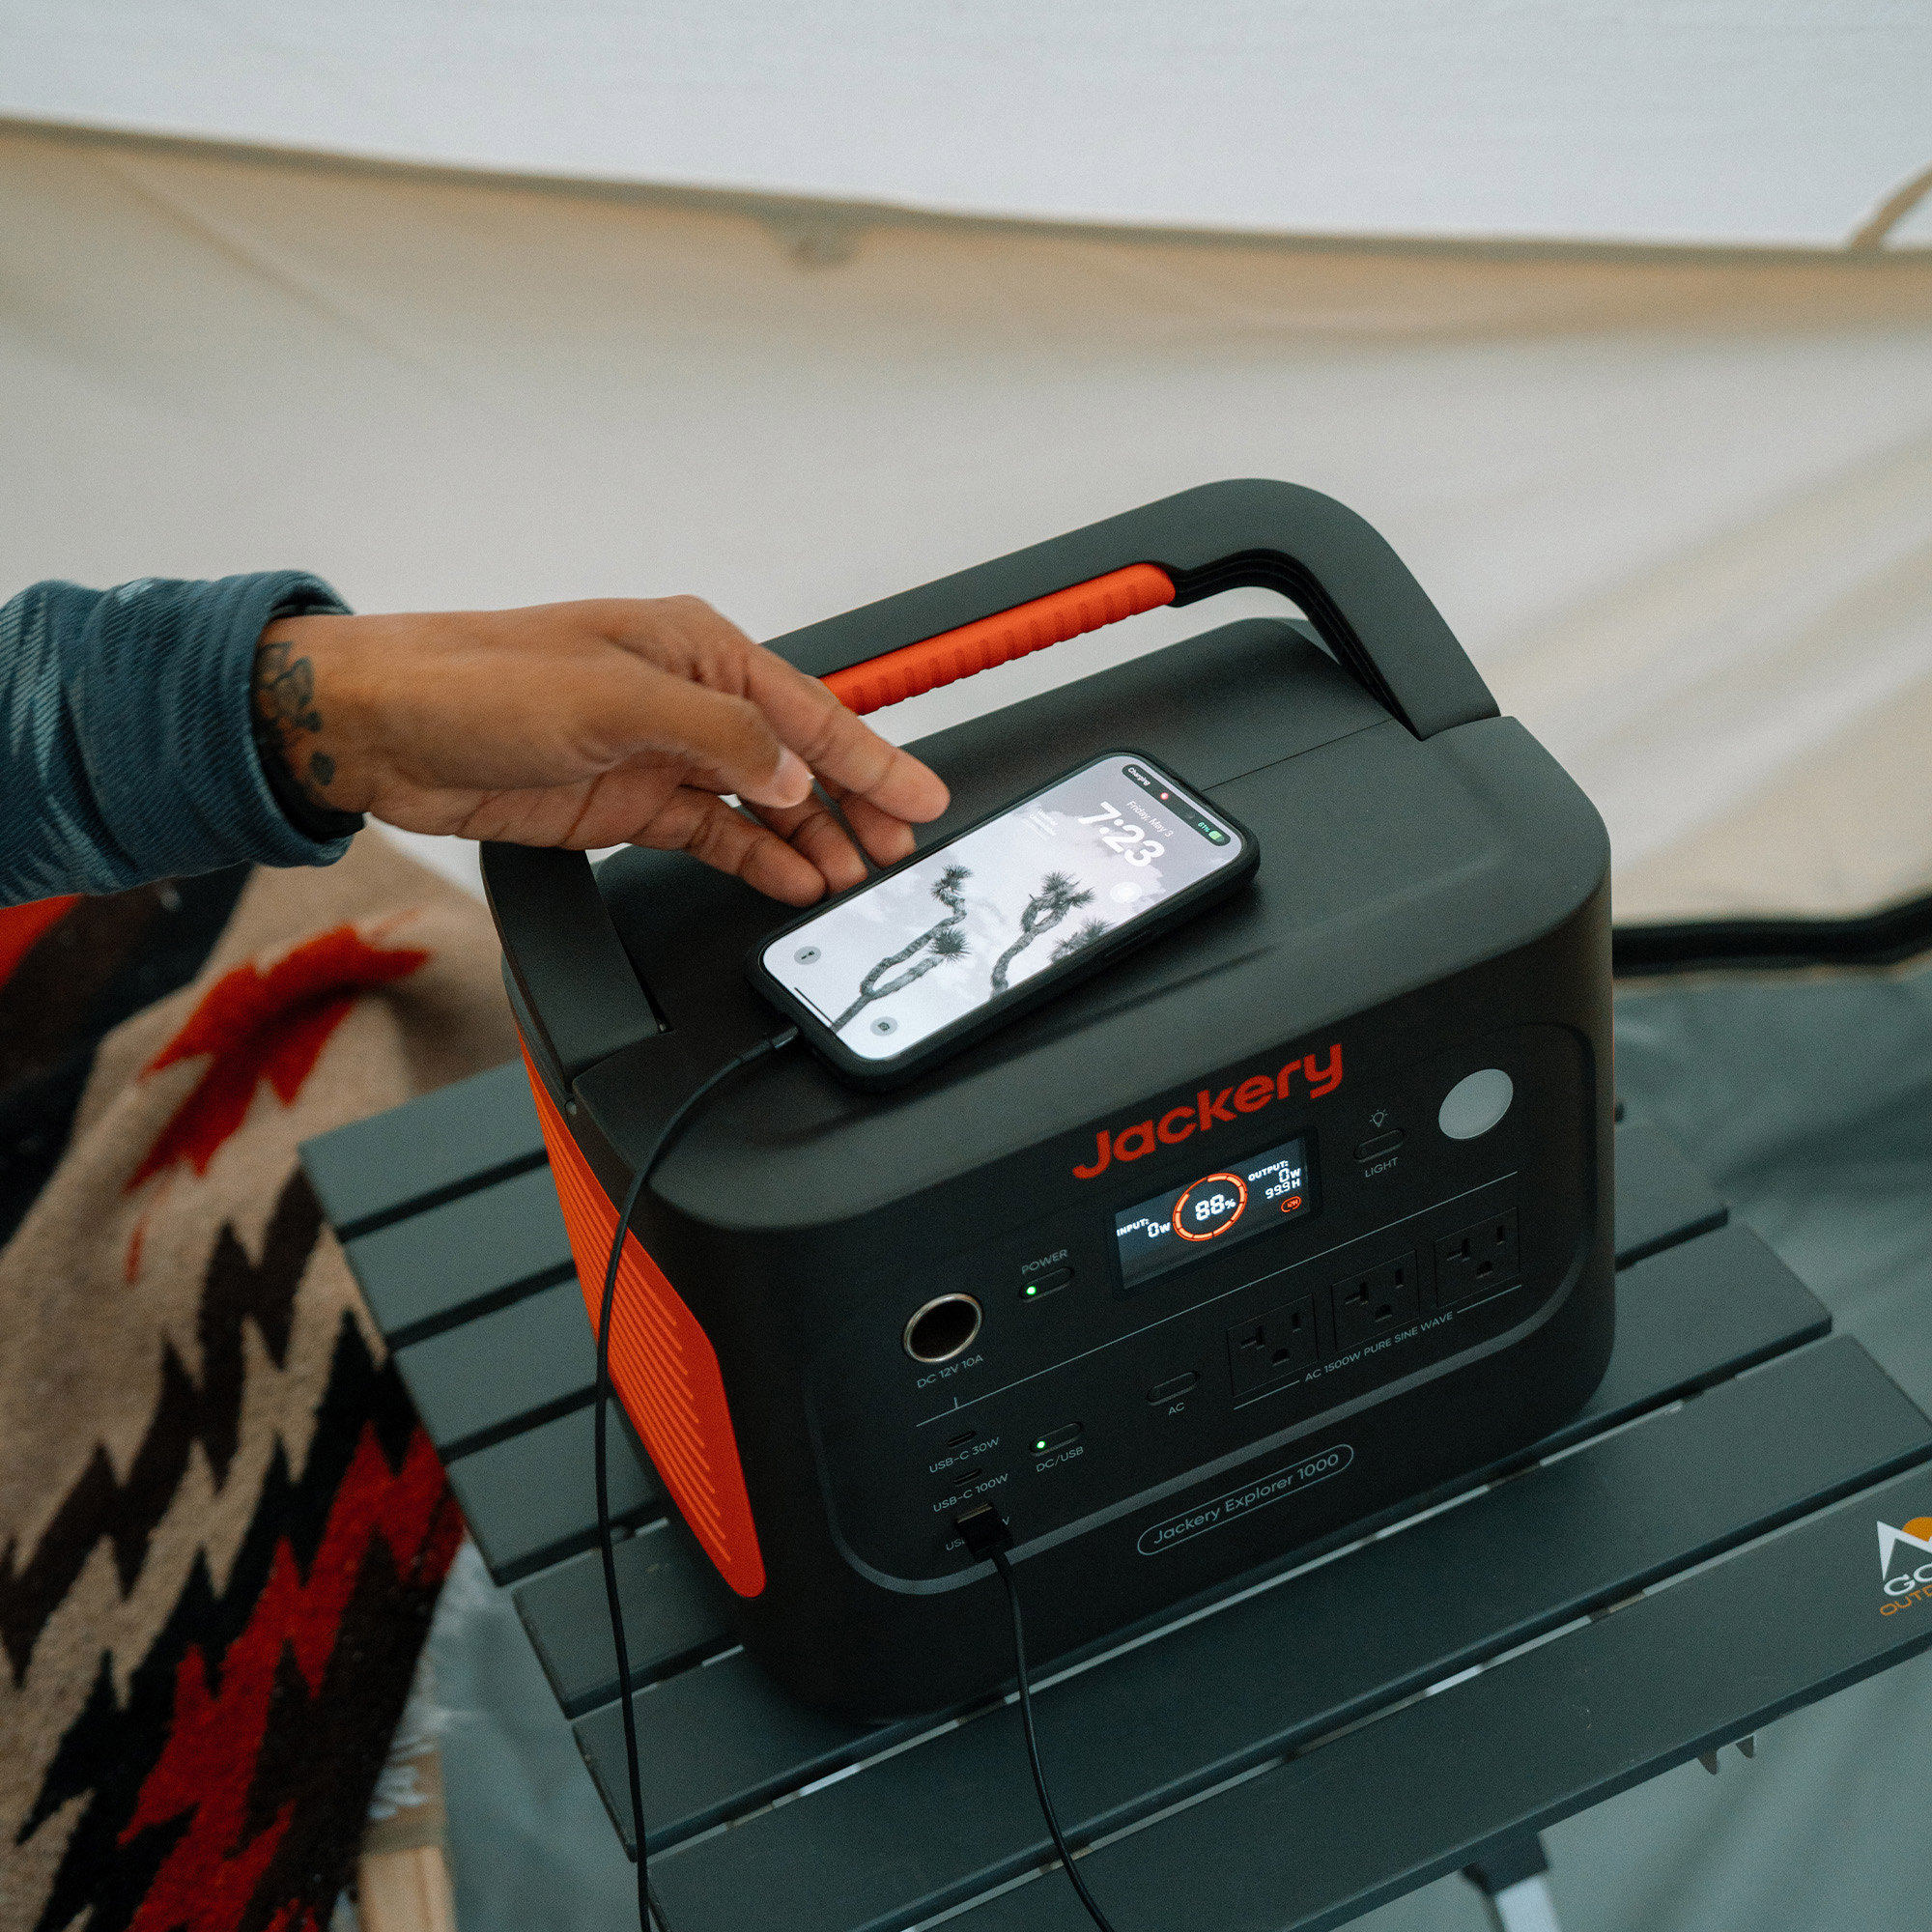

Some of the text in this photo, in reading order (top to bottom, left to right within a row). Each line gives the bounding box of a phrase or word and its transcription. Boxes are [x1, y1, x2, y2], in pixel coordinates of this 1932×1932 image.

[1125, 800, 1150, 825] Friday,
[1150, 817, 1167, 833] May
[1077, 801, 1165, 867] 7:23
[1071, 1042, 1344, 1179] Jackery
[1248, 1160, 1289, 1181] OUTPUT:
[1364, 1156, 1399, 1178] LIGHT
[1194, 1194, 1236, 1222] 88%
[1116, 1217, 1150, 1237] INPUT:
[1021, 1248, 1068, 1275] POWER
[1304, 1311, 1455, 1382] AC 1500W PURE SINE WAVE
[917, 1354, 984, 1388] DC 12V 10A
[1167, 1402, 1185, 1416] AC
[928, 1436, 1000, 1473] USB-C 30W
[1036, 1446, 1085, 1473] DC/USB
[932, 1473, 1009, 1513] USB-C 100W
[1153, 1453, 1340, 1545] Jackery Explorer 1000
